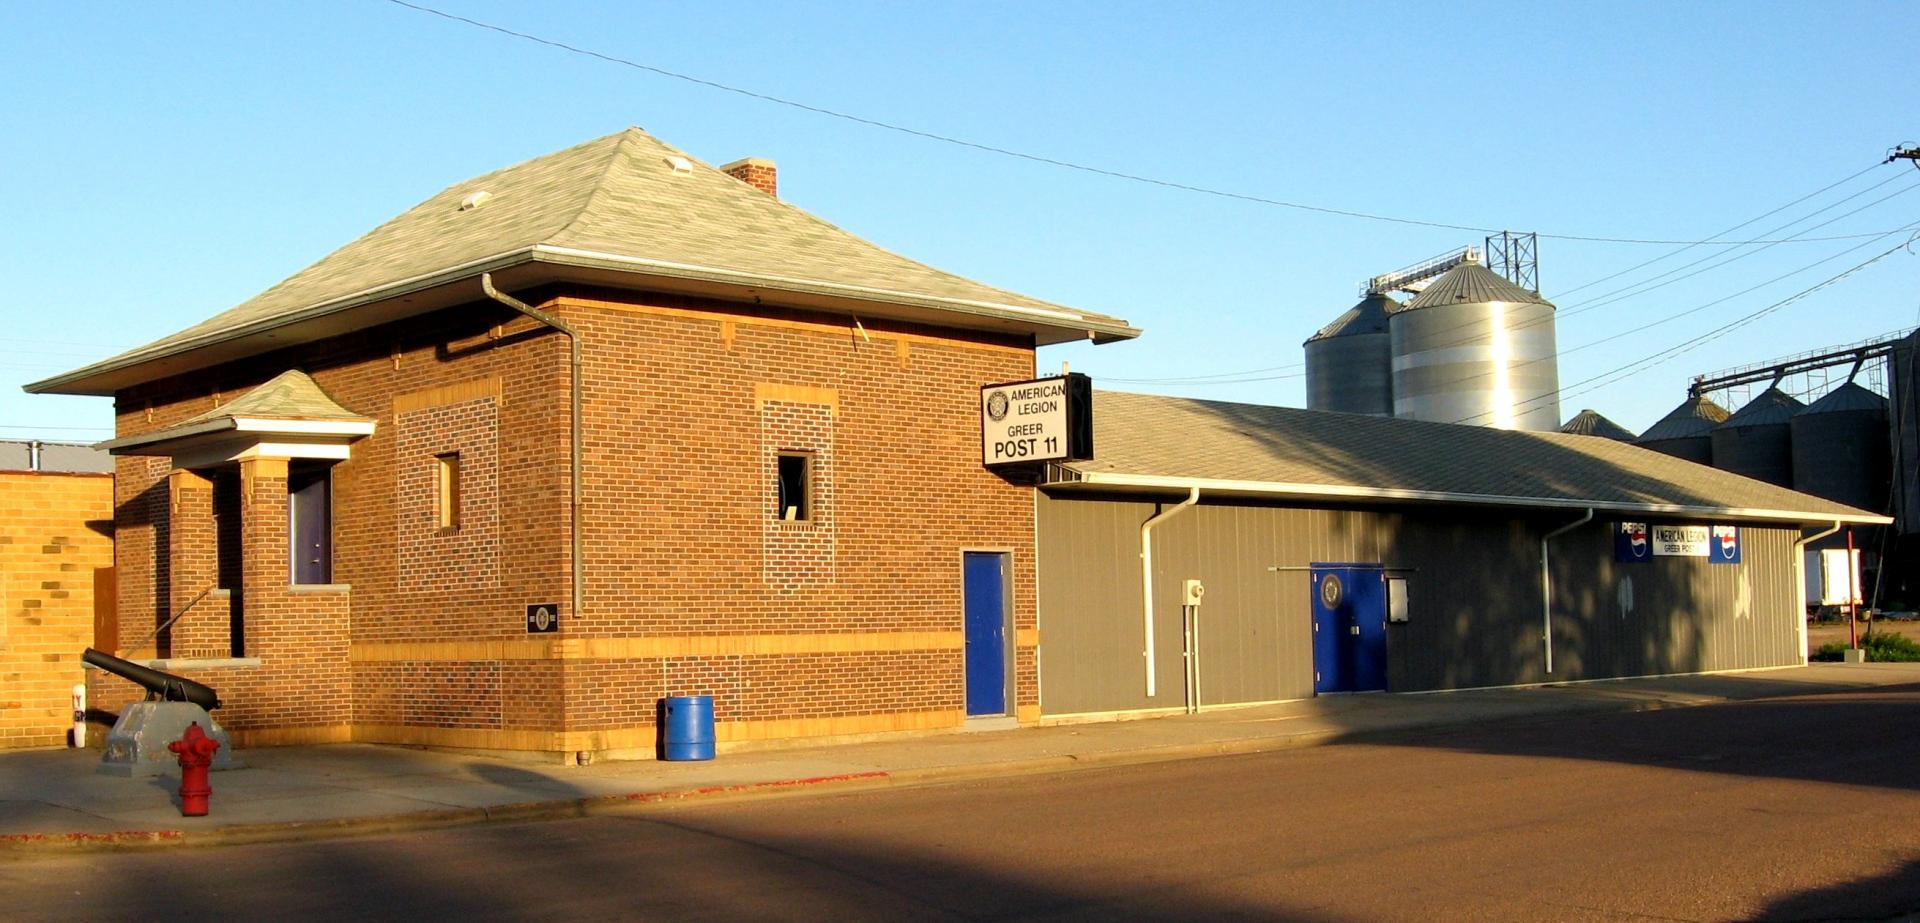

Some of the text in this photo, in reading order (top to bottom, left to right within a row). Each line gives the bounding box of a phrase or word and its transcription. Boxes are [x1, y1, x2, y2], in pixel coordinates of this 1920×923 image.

[1011, 385, 1065, 400] AMERICAN
[1018, 401, 1057, 415] LEGION
[1007, 423, 1043, 437] GREER
[995, 436, 1057, 458] POST 11
[1621, 522, 1646, 534] PEPSI
[1655, 529, 1685, 542] AMERICAN
